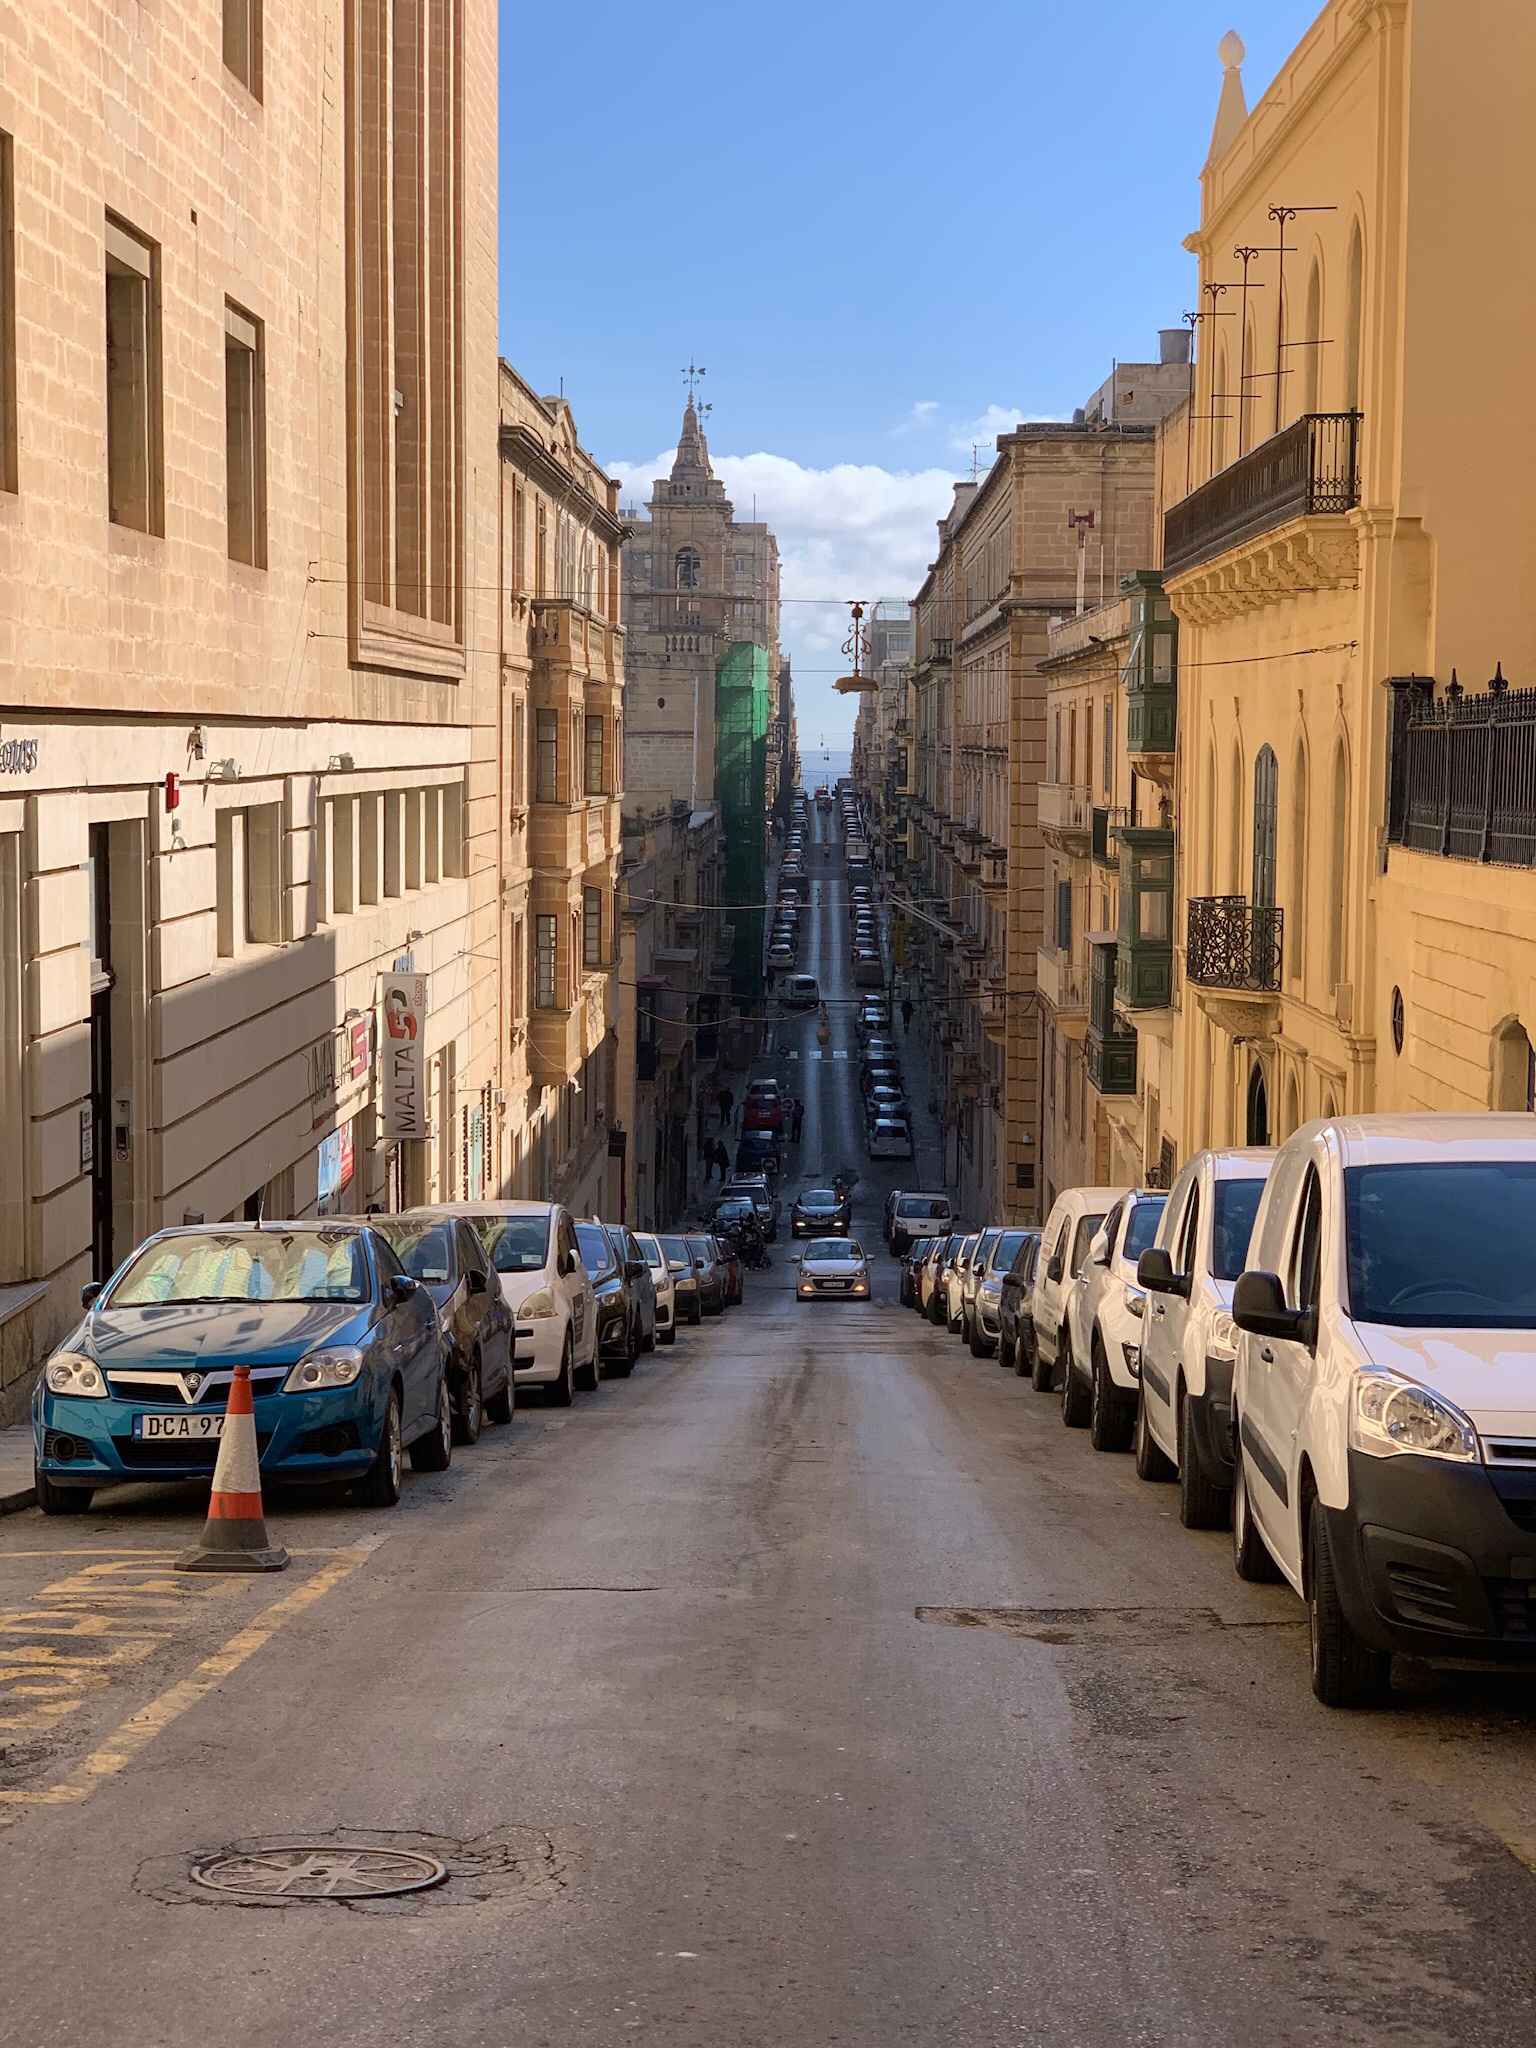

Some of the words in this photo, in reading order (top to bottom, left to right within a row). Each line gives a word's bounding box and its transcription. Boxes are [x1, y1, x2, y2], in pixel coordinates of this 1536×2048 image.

[395, 1045, 417, 1132] MALTA
[148, 1416, 190, 1436] DCA
[200, 1416, 225, 1436] 97
